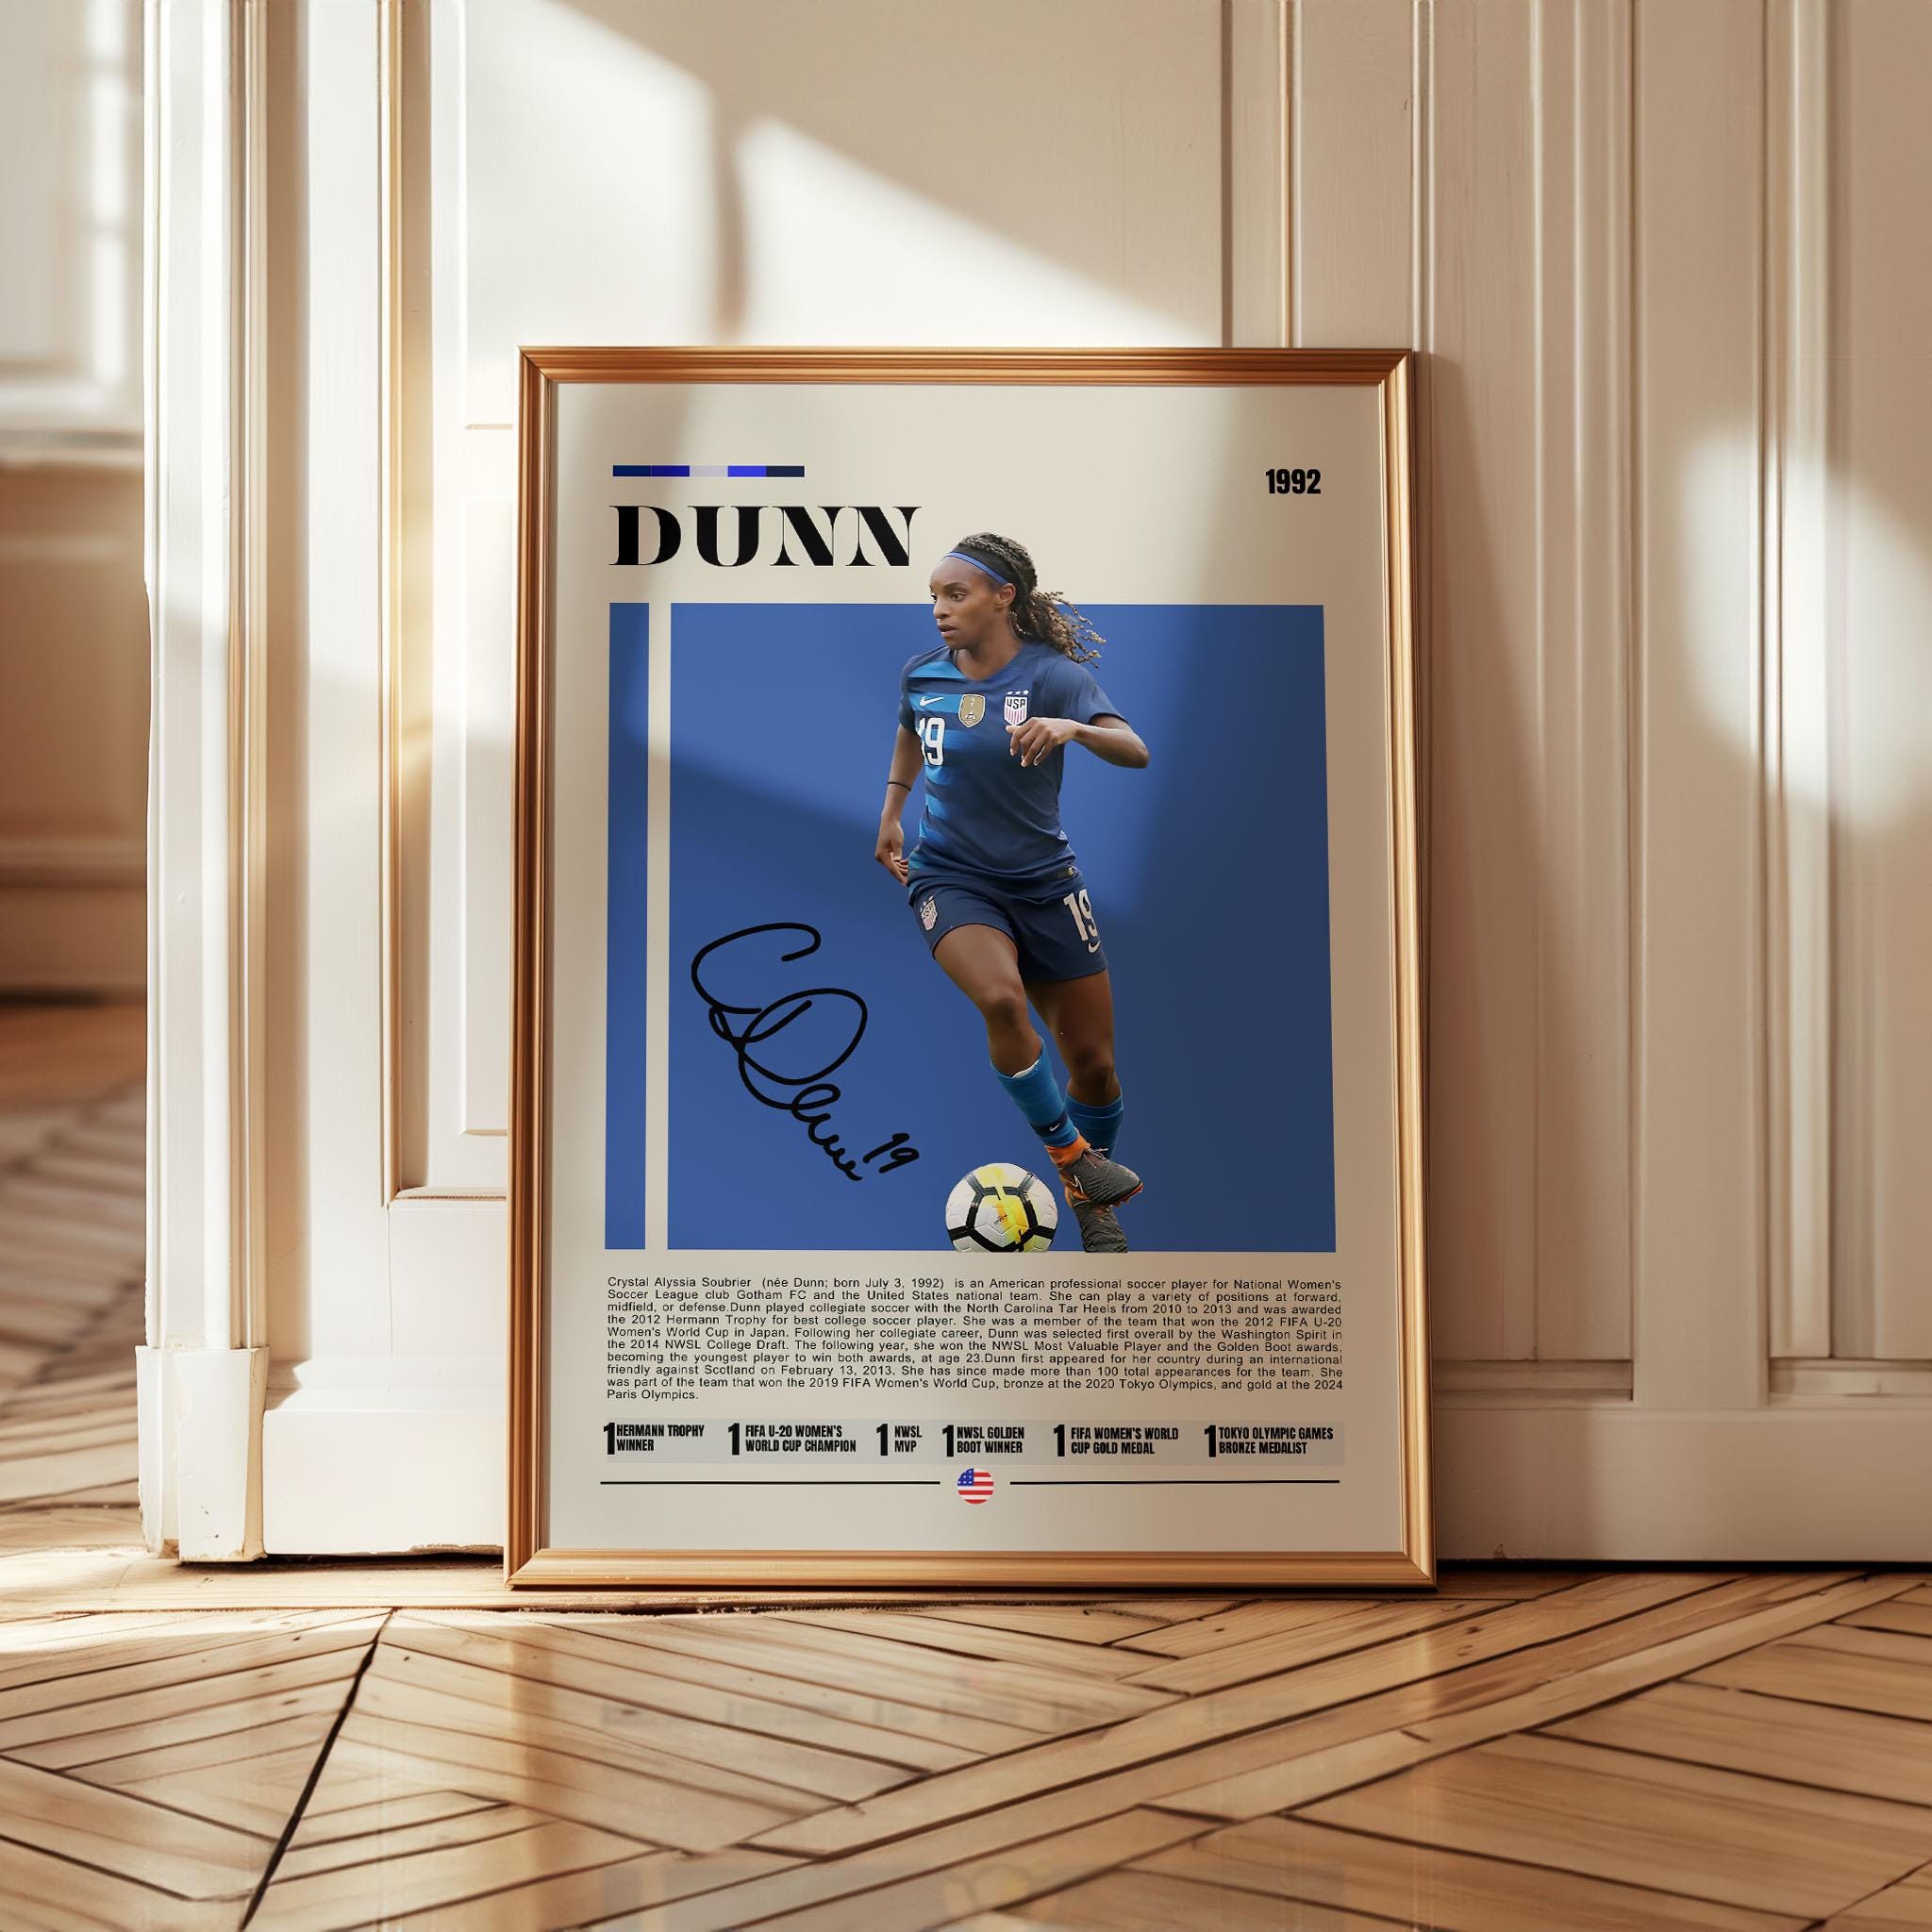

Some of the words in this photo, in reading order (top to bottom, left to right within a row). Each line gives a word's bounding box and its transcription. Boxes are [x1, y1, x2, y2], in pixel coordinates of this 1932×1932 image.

[1266, 469, 1321, 493] 1992
[608, 505, 923, 567] DUNN
[915, 717, 945, 766] 19
[1063, 889, 1100, 941] 19
[862, 1132, 920, 1174] 19
[608, 1276, 648, 1289] Crystal
[655, 1276, 695, 1289] Alyssia
[702, 1276, 751, 1286] Soubrier
[762, 1276, 788, 1289] (née
[794, 1277, 827, 1288] Dunn;
[866, 1277, 889, 1290] July
[912, 1277, 943, 1290] 1992)
[990, 1278, 1044, 1288] American
[1051, 1278, 1121, 1291] professional
[1172, 1278, 1208, 1291] player
[1234, 1279, 1282, 1289] National
[1288, 1279, 1341, 1289] Women's
[608, 1289, 648, 1298] Soccer
[656, 1289, 698, 1301] League
[706, 1289, 729, 1298] club
[737, 1289, 782, 1299] Gotham
[790, 1290, 806, 1299] FC
[868, 1290, 904, 1299] United
[912, 1290, 949, 1300] States
[957, 1291, 1002, 1300] national
[1010, 1291, 1041, 1300] team.
[1049, 1291, 1072, 1300] She
[1108, 1291, 1131, 1303] play
[1152, 1291, 1191, 1304] variety
[1216, 1291, 1269, 1304] positions
[1293, 1291, 1341, 1303] forward,
[608, 1301, 657, 1312] midfield,
[678, 1302, 760, 1311] defense.Dunn
[766, 1302, 804, 1314] played
[809, 1302, 865, 1314] collegiate
[967, 1303, 998, 1312] North
[1005, 1303, 1053, 1312] Carolina
[1058, 1303, 1078, 1312] Tar
[1084, 1303, 1116, 1313] Heels
[1153, 1304, 1182, 1313] 2010
[1201, 1304, 1231, 1313] 2013
[1291, 1304, 1341, 1314] awarded
[632, 1314, 659, 1324] 2012
[667, 1314, 719, 1324] Hermann
[725, 1314, 766, 1326] Trophy
[824, 1315, 866, 1327] college
[917, 1315, 956, 1327] player.
[963, 1315, 986, 1324] She
[1034, 1316, 1081, 1325] member
[1245, 1317, 1273, 1326] 2012
[1280, 1317, 1307, 1326] FIFA
[1314, 1317, 1341, 1326] U-20
[608, 1326, 660, 1336] Women's
[667, 1326, 700, 1336] World
[706, 1326, 728, 1339] Cup
[750, 1326, 789, 1339] Japan.
[795, 1327, 852, 1340] Following
[880, 1327, 937, 1340] collegiate
[941, 1330, 982, 1339] career,
[989, 1328, 1018, 1338] Dunn
[1053, 1328, 1101, 1338] selected
[1107, 1328, 1129, 1338] first
[1134, 1328, 1174, 1338] overall
[1222, 1329, 1290, 1341] Washington
[1296, 1329, 1326, 1341] Spirit
[631, 1339, 659, 1349] 2014
[665, 1339, 701, 1349] NWSL
[708, 1339, 751, 1351] College
[757, 1339, 789, 1349] Draft.
[795, 1339, 816, 1349] The
[823, 1340, 874, 1352] following
[879, 1341, 908, 1352] year,
[992, 1340, 1028, 1350] NWSL
[1035, 1341, 1062, 1350] Most
[1068, 1341, 1119, 1350] Valuable
[1124, 1341, 1161, 1353] Player
[1218, 1341, 1258, 1351] Golden
[1265, 1341, 1291, 1351] Boot
[1297, 1341, 1341, 1352] awards,
[608, 1351, 663, 1363] becoming
[694, 1351, 747, 1363] youngest
[754, 1351, 790, 1363] player
[870, 1352, 915, 1363] awards,
[966, 1353, 1015, 1362] 23.Dunn
[1022, 1353, 1043, 1362] first
[1049, 1353, 1104, 1365] appeared
[1158, 1353, 1200, 1365] country
[1270, 1354, 1341, 1363] international
[608, 1363, 650, 1375] friendly
[657, 1363, 698, 1375] against
[705, 1363, 756, 1374] Scotland
[782, 1364, 833, 1376] February
[841, 1364, 857, 1375] 13,
[863, 1364, 895, 1374] 2013.
[902, 1364, 924, 1374] She
[1098, 1365, 1118, 1374] 100
[1124, 1365, 1149, 1375] total
[1156, 1368, 1230, 1378] appearances
[1282, 1366, 1313, 1375] team.
[1321, 1366, 1342, 1376] She
[809, 1376, 838, 1386] 2019
[843, 1376, 871, 1386] FIFA
[875, 1376, 928, 1387] Women's
[933, 1377, 967, 1387] World
[972, 1377, 998, 1390] Cup,
[1004, 1377, 1043, 1387] bronze
[1086, 1378, 1114, 1388] 2020
[1119, 1378, 1155, 1391] Tokyo
[1159, 1378, 1216, 1391] Olympics,
[1247, 1378, 1272, 1391] gold
[1315, 1379, 1342, 1389] 2024
[608, 1388, 637, 1397] Paris
[641, 1388, 698, 1400] Olympics.
[617, 1424, 664, 1437] HERMANN
[668, 1424, 705, 1437] TROPHY
[746, 1425, 765, 1437] FIFA
[769, 1425, 791, 1437] U-20
[795, 1425, 842, 1437] WOMEN'S
[894, 1425, 922, 1438] NWSL
[957, 1426, 985, 1439] NWSL
[988, 1426, 1024, 1439] GOLDEN
[1071, 1427, 1091, 1440] FIFA
[1094, 1427, 1141, 1440] WOMEN'S
[1145, 1427, 1178, 1440] WORLD
[1219, 1427, 1249, 1440] TOKYO
[1253, 1427, 1295, 1440] OLYMPIC
[1299, 1427, 1334, 1440] GAMES
[604, 1423, 615, 1455] 1
[617, 1440, 654, 1451] WINNER
[728, 1424, 740, 1455] 1
[746, 1440, 779, 1452] WORLD
[783, 1440, 802, 1452] CUP
[805, 1440, 856, 1452] CHAMPION
[876, 1424, 888, 1456] 1
[942, 1424, 954, 1457] 1
[1054, 1424, 1065, 1457] 1
[1205, 1424, 1216, 1457] 1
[894, 1441, 917, 1452] MVP
[957, 1441, 982, 1453] BOOT
[985, 1441, 1023, 1453] WINNER
[1071, 1442, 1090, 1454] CUP
[1093, 1442, 1118, 1454] GOLD
[1122, 1442, 1155, 1454] MEDAL
[1219, 1442, 1256, 1454] BRONZE
[1259, 1442, 1307, 1454] MEDALIST
